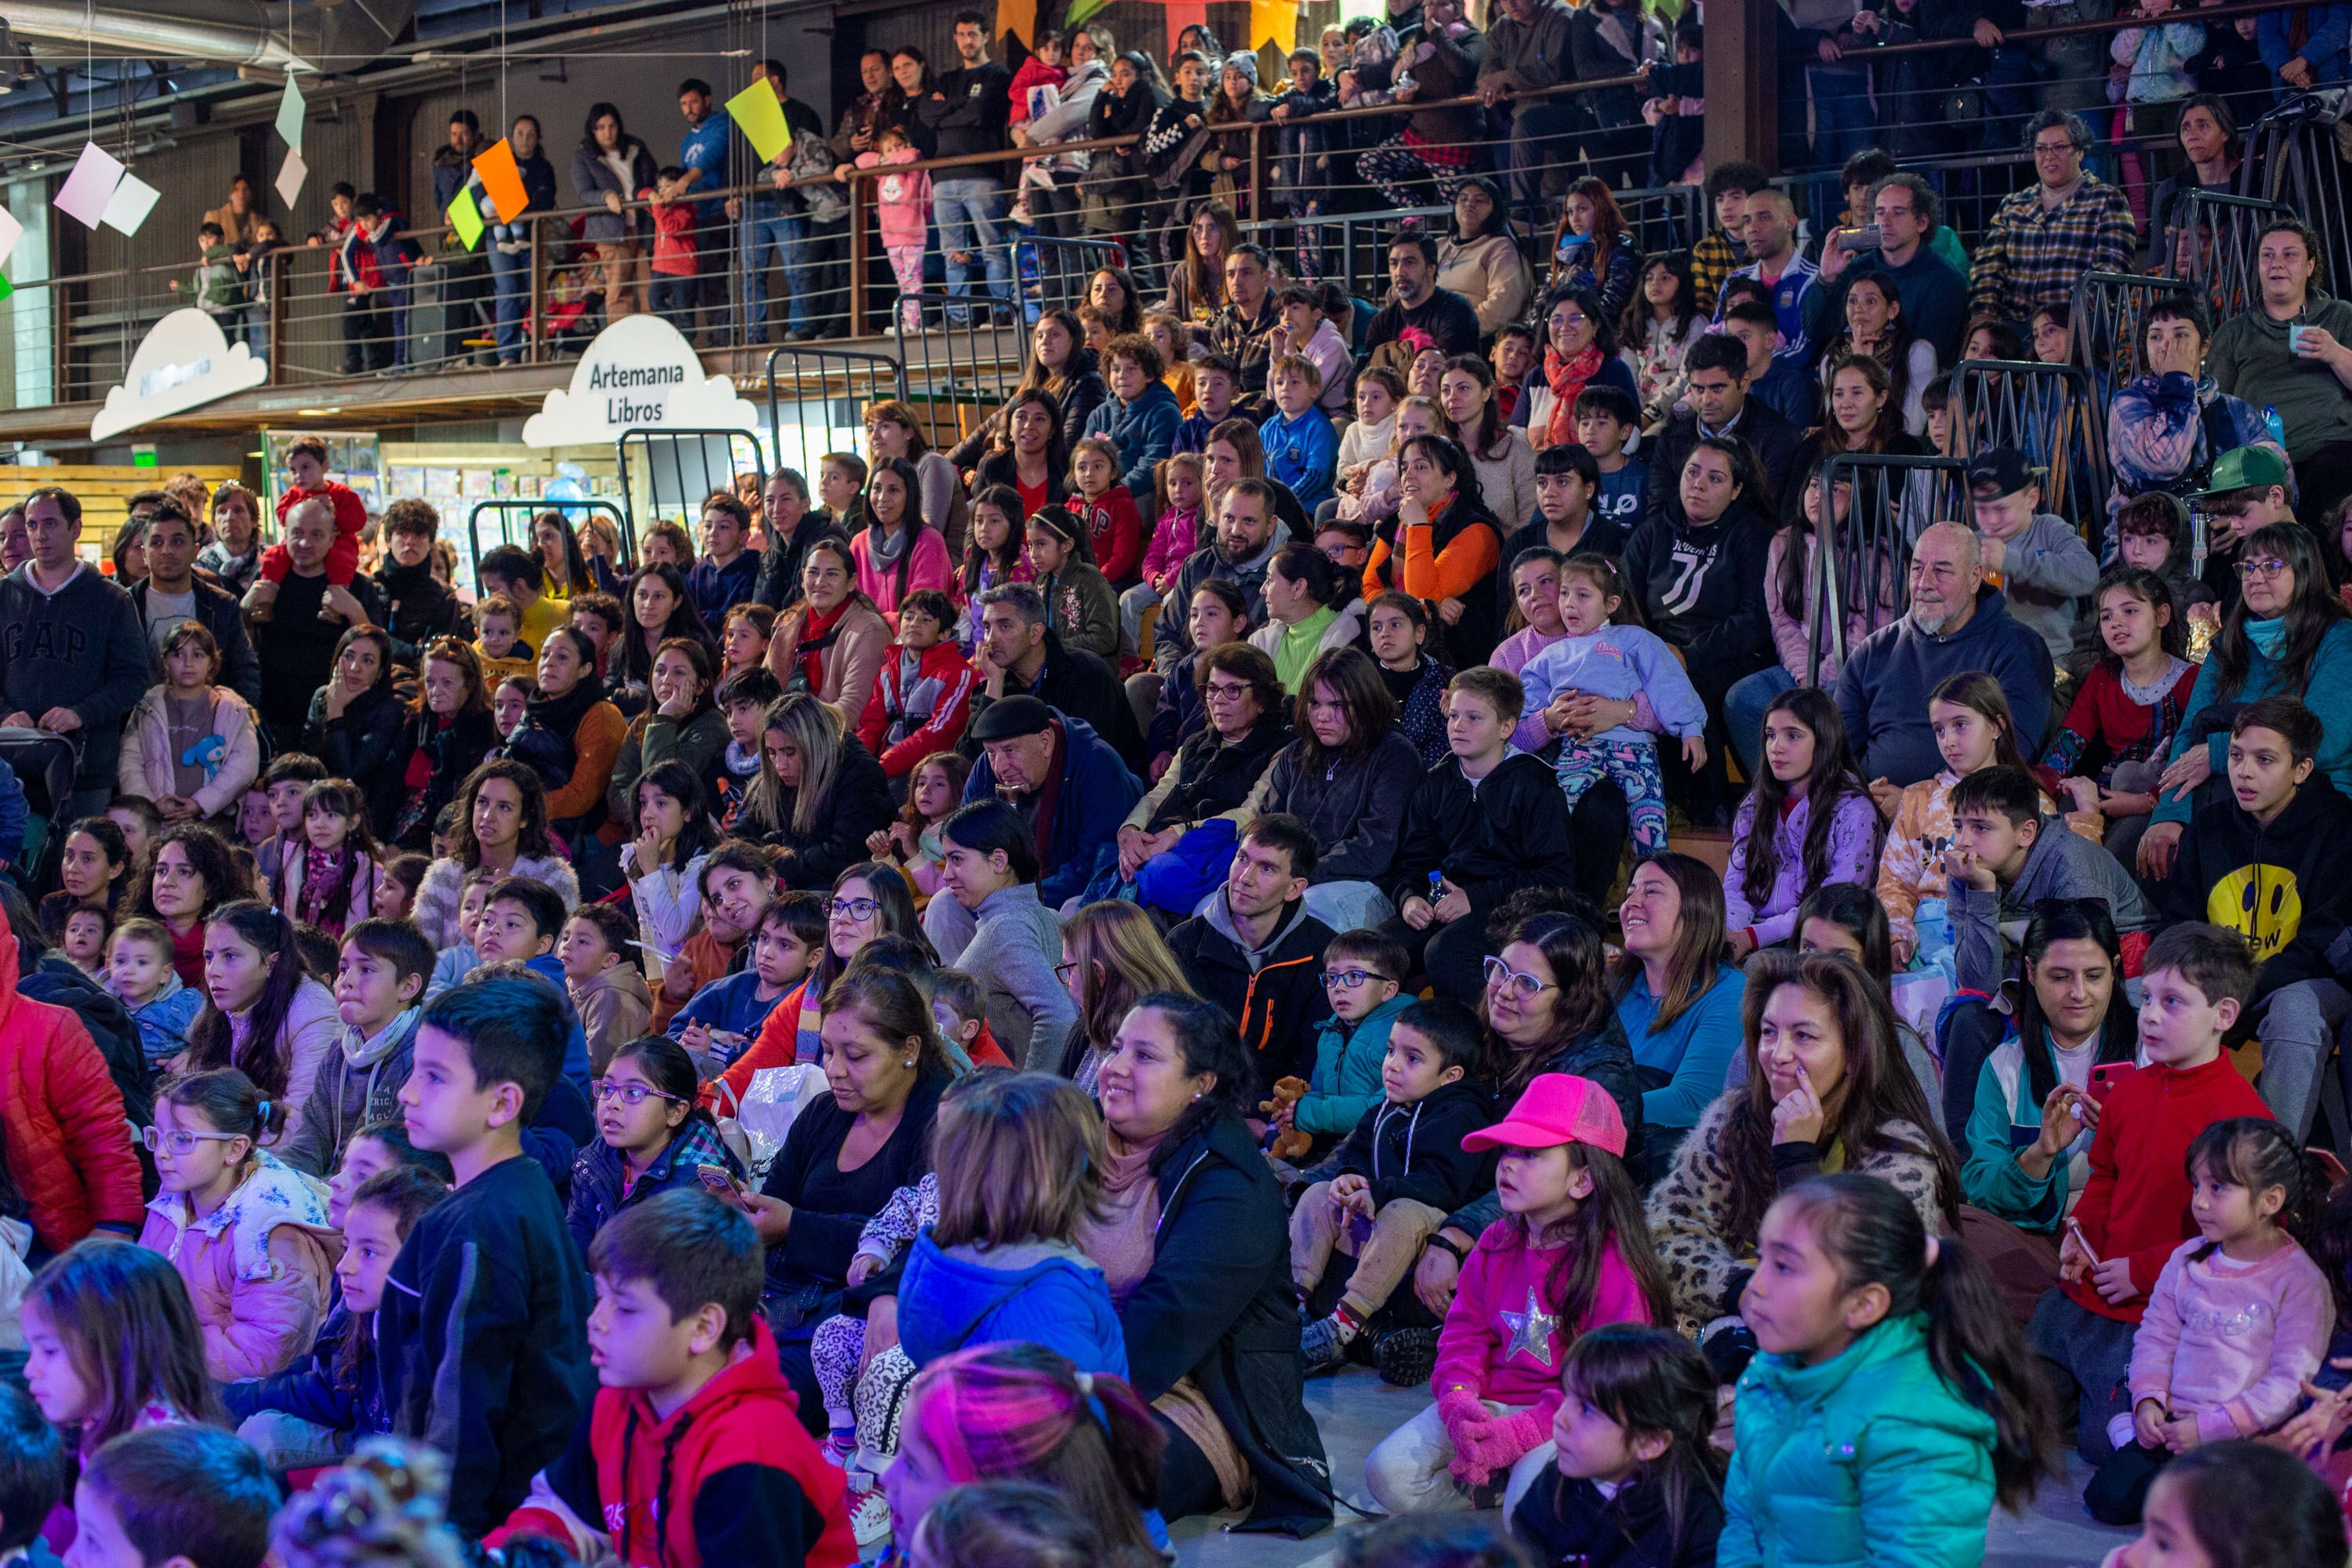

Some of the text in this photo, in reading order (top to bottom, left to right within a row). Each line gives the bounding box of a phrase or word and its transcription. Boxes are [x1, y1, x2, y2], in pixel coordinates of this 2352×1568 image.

[589, 363, 684, 390] Artemania
[608, 396, 662, 424] Libros
[2, 620, 87, 668] GAP
